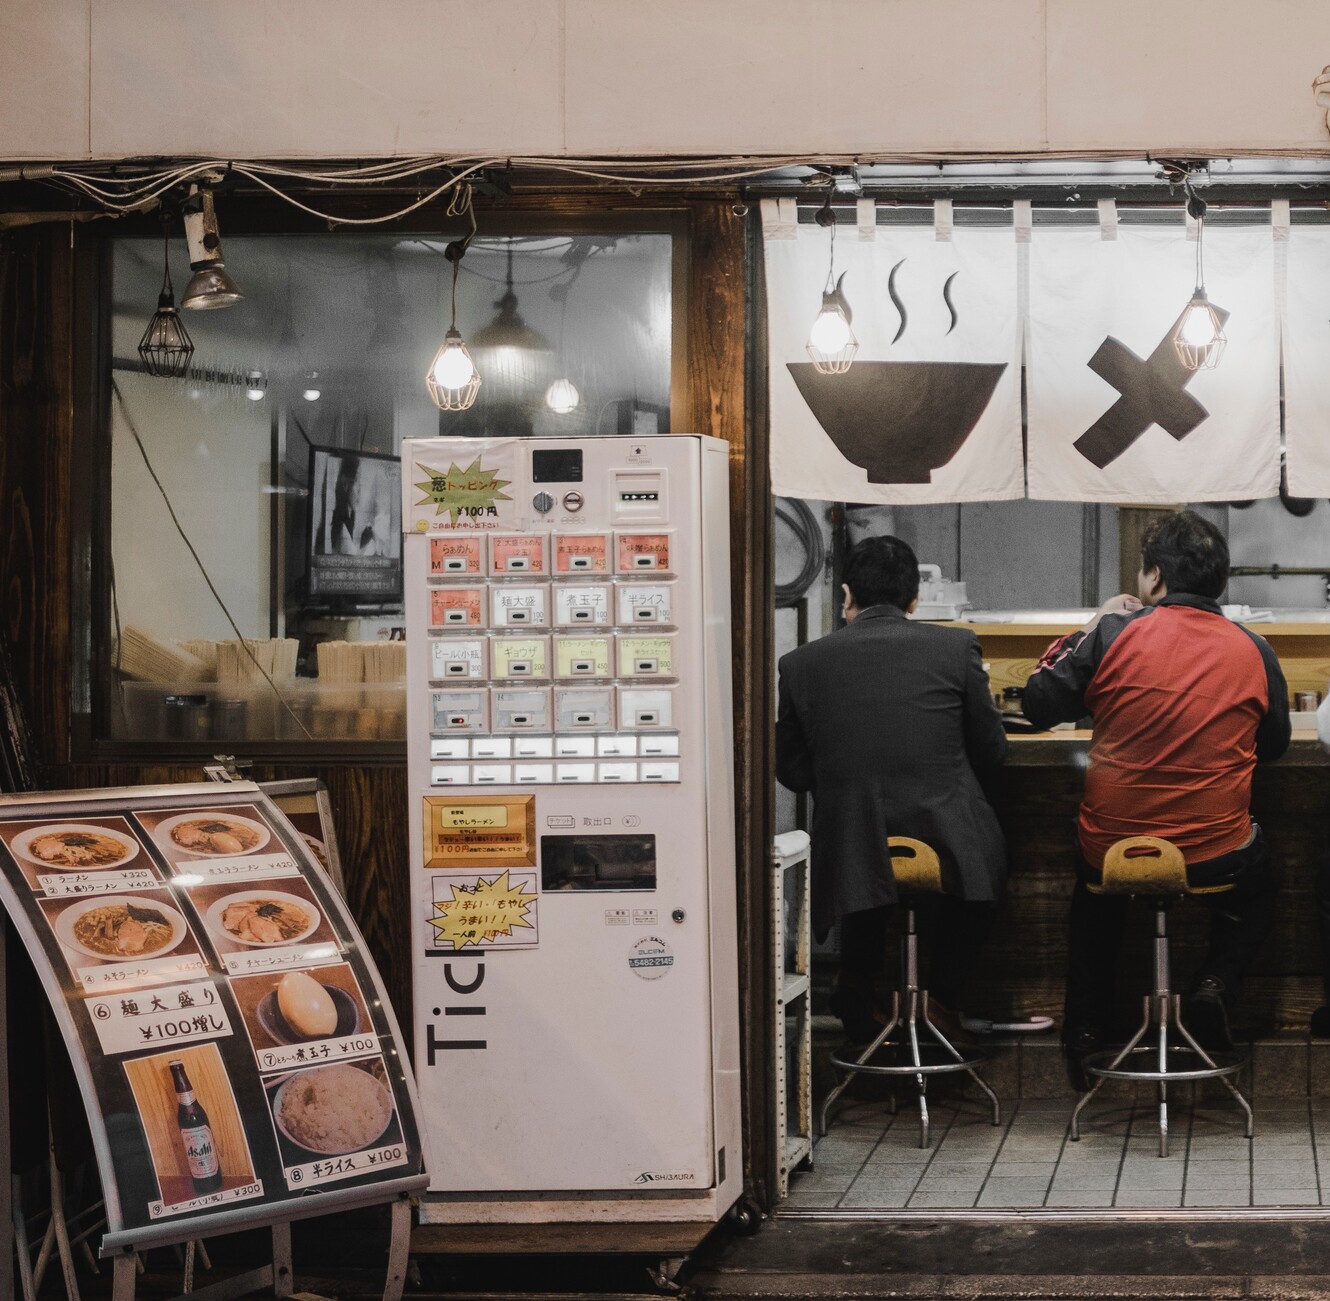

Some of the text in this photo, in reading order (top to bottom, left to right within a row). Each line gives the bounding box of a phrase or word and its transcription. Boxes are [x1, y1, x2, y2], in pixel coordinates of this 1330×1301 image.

[442, 544, 474, 554] らぁめん
[432, 561, 440, 569] M
[495, 561, 503, 570] L
[566, 594, 603, 606] 煮玉子
[627, 594, 665, 605] 半ライス
[504, 646, 537, 658] ギョウザ
[583, 817, 612, 826] 取出口
[58, 874, 89, 883] ラーメン
[139, 1014, 224, 1039] ¥100増し
[339, 1038, 374, 1052] ¥100
[188, 1142, 212, 1157] Asahi
[313, 1158, 356, 1178] 半ライス
[368, 1148, 401, 1164] ¥100
[234, 1184, 260, 1196] ¥300
